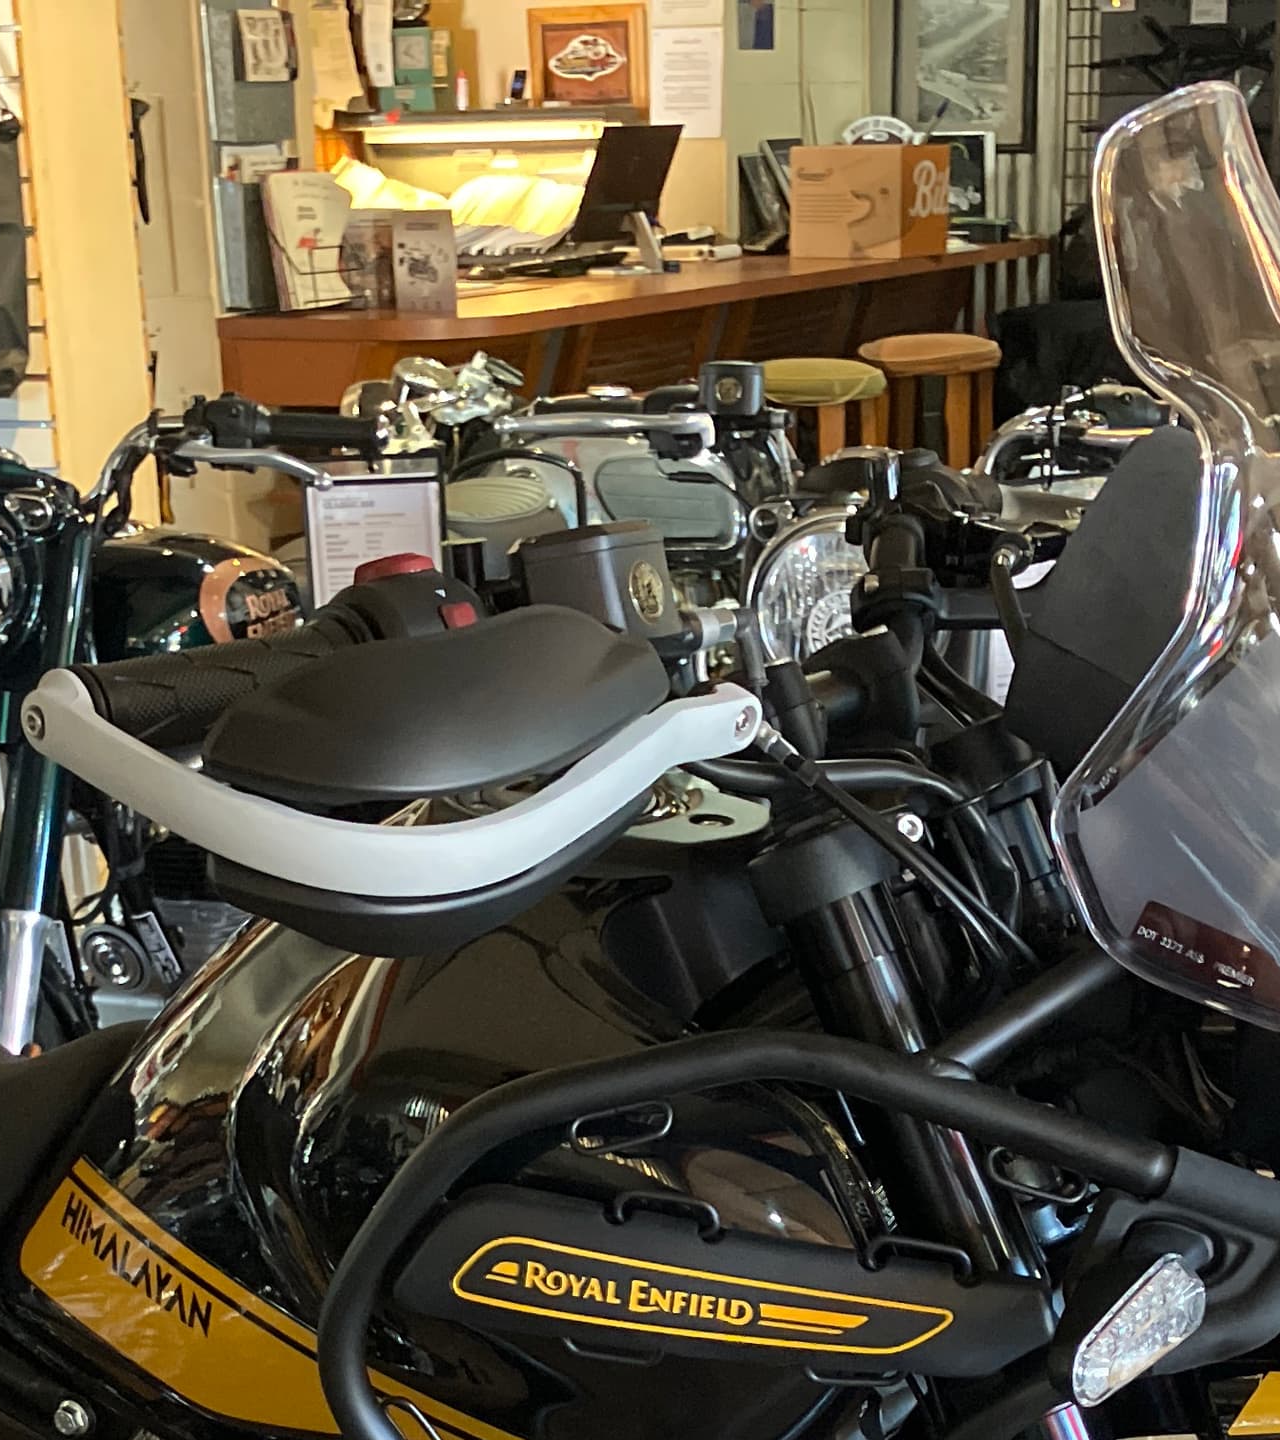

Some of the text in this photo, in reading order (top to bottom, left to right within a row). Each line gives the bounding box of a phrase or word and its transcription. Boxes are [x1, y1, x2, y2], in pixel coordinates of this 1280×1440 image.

[1137, 925, 1157, 940] DOT
[61, 1191, 213, 1339] HIMALAYAN
[524, 1260, 754, 1327] ROYAL ENFIELD
